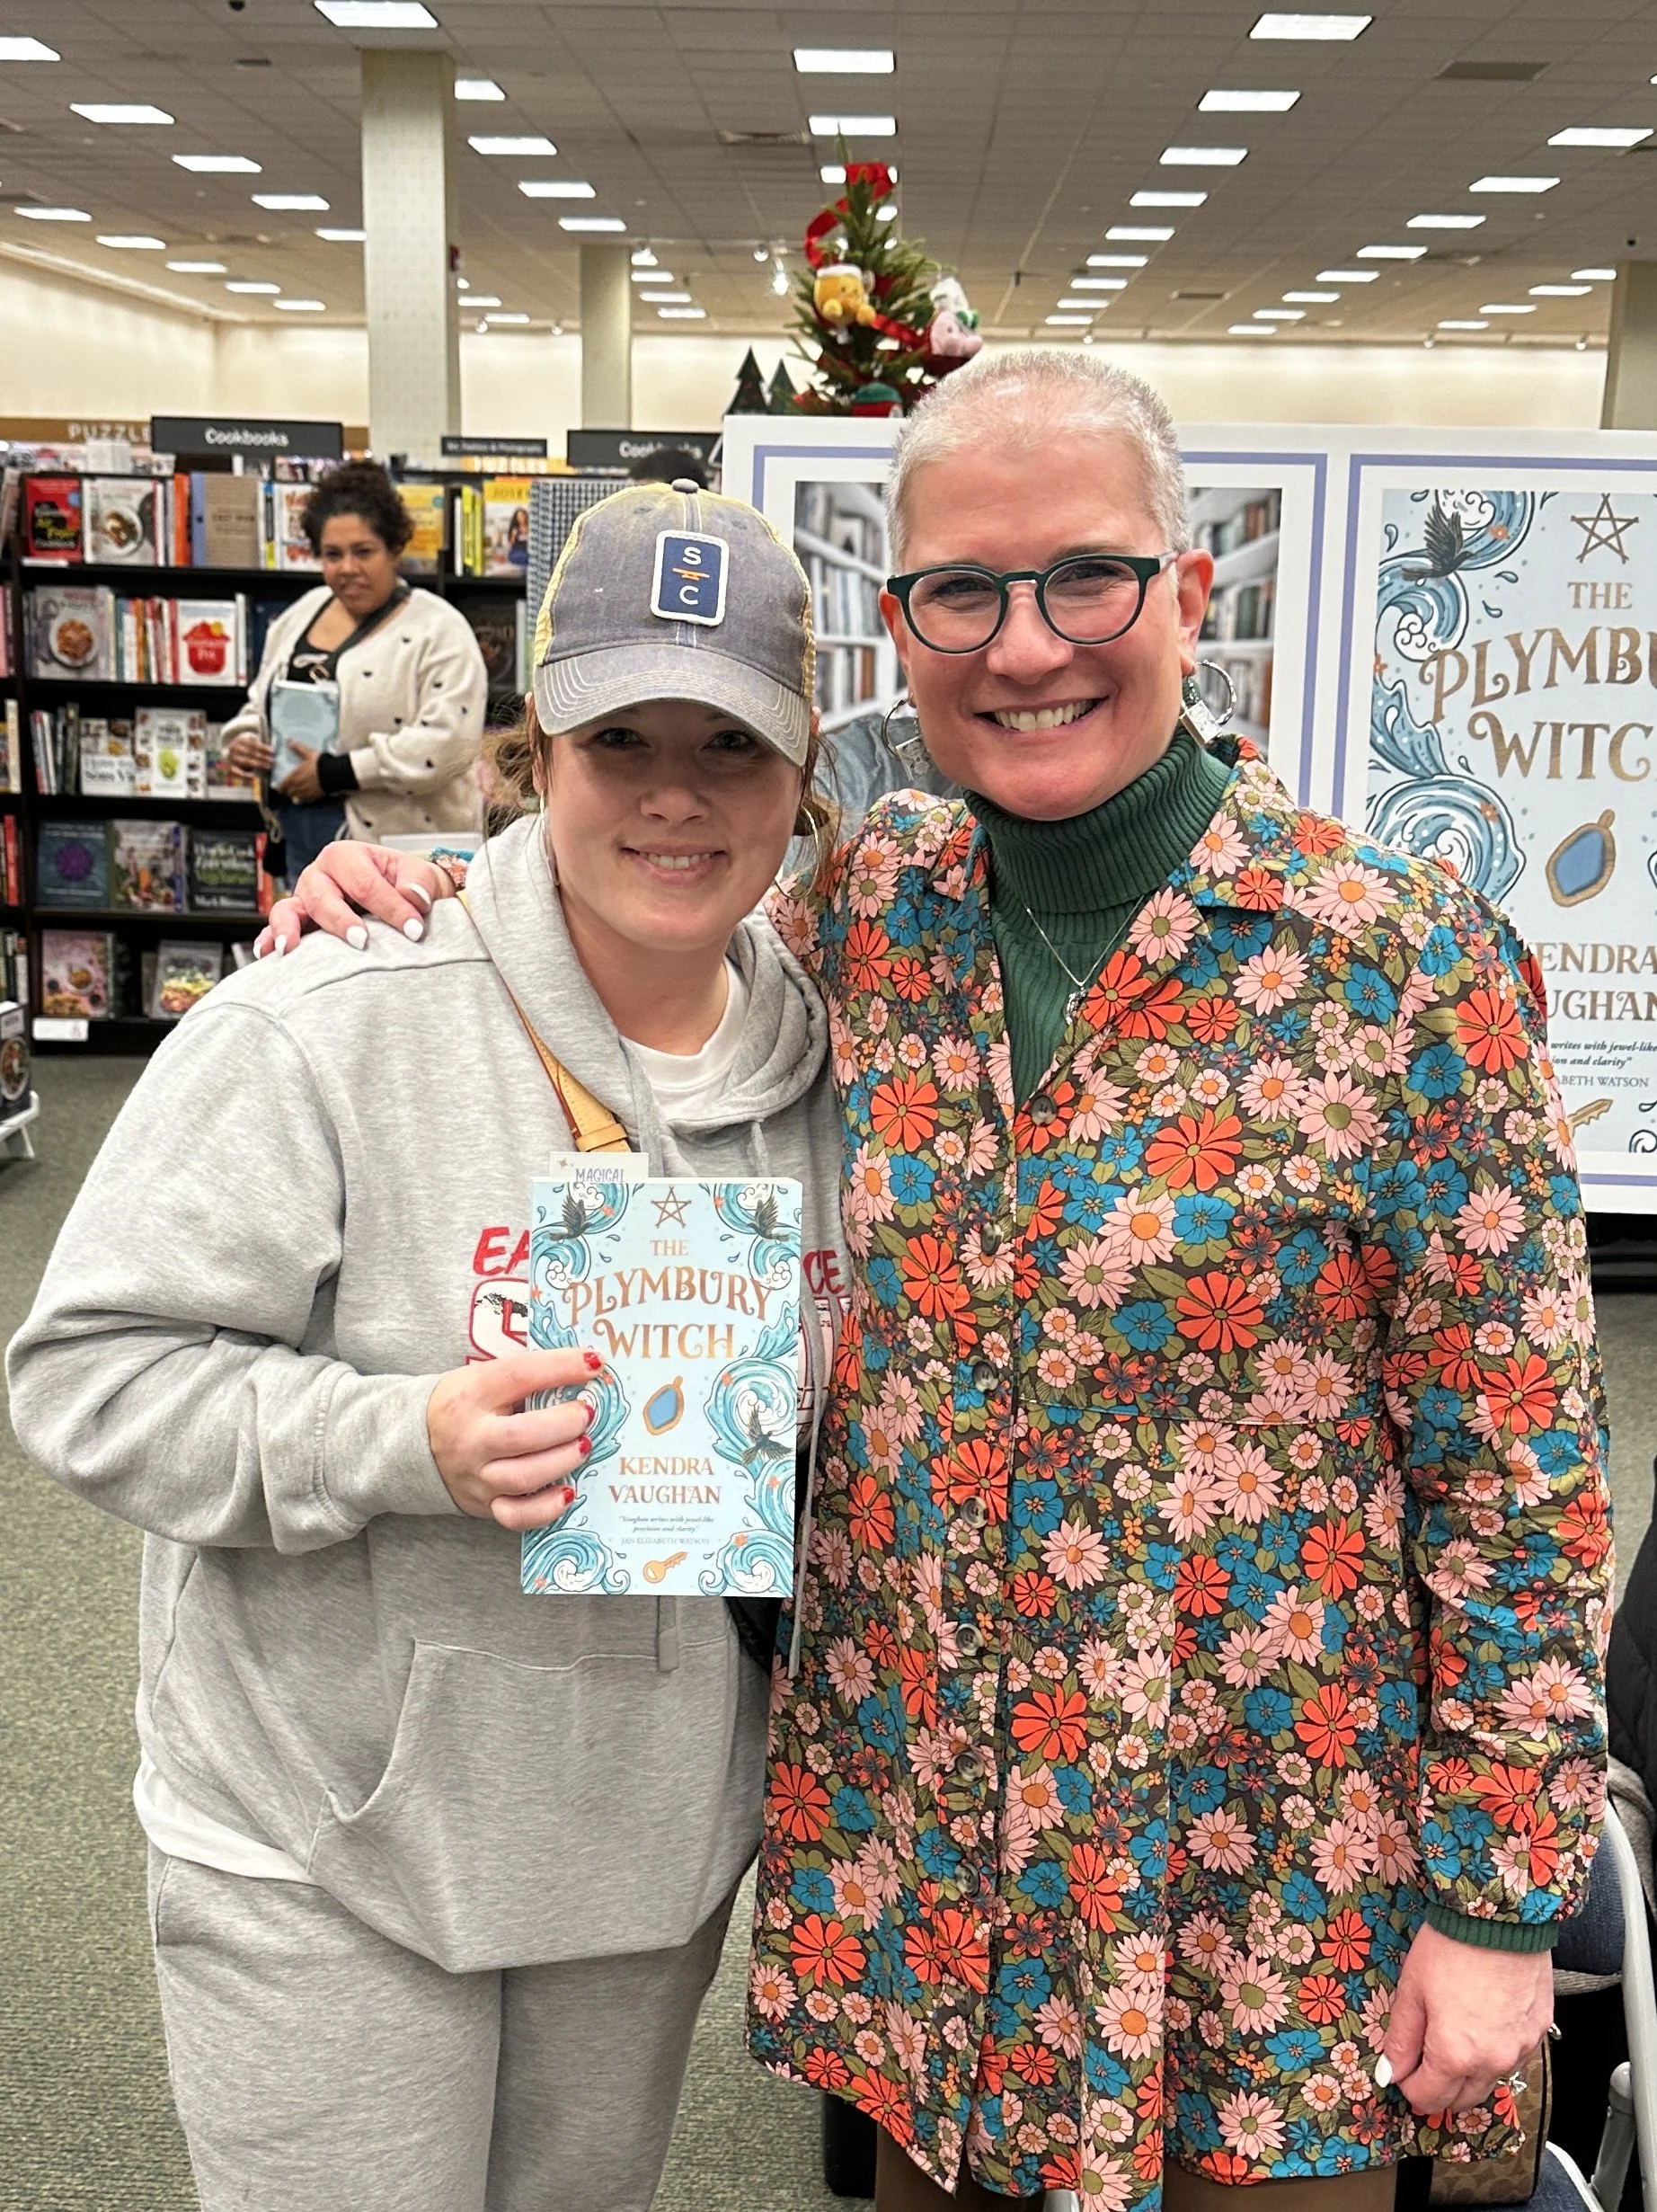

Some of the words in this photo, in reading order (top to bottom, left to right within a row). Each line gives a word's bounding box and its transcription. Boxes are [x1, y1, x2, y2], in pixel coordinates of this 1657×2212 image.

[204, 426, 289, 448] Cookbooks
[682, 546, 702, 565] S
[679, 585, 699, 605] C
[1568, 582, 1633, 609] THE
[1419, 626, 1657, 724] PLYMB
[1531, 941, 1657, 974] ENDRA
[1551, 1042, 1582, 1050] writes
[1584, 1040, 1607, 1051] with
[1607, 1042, 1657, 1053] jewel-like
[1570, 1055, 1591, 1065] and
[1597, 1076, 1650, 1088] WATSON
[575, 1168, 625, 1183] MAGICAL
[650, 1239, 690, 1257] THE
[562, 1266, 775, 1327] PLYMBURY
[592, 1319, 735, 1360] WITCH
[619, 1456, 715, 1476] KENDRA
[608, 1485, 722, 1505] VAUGHAN
